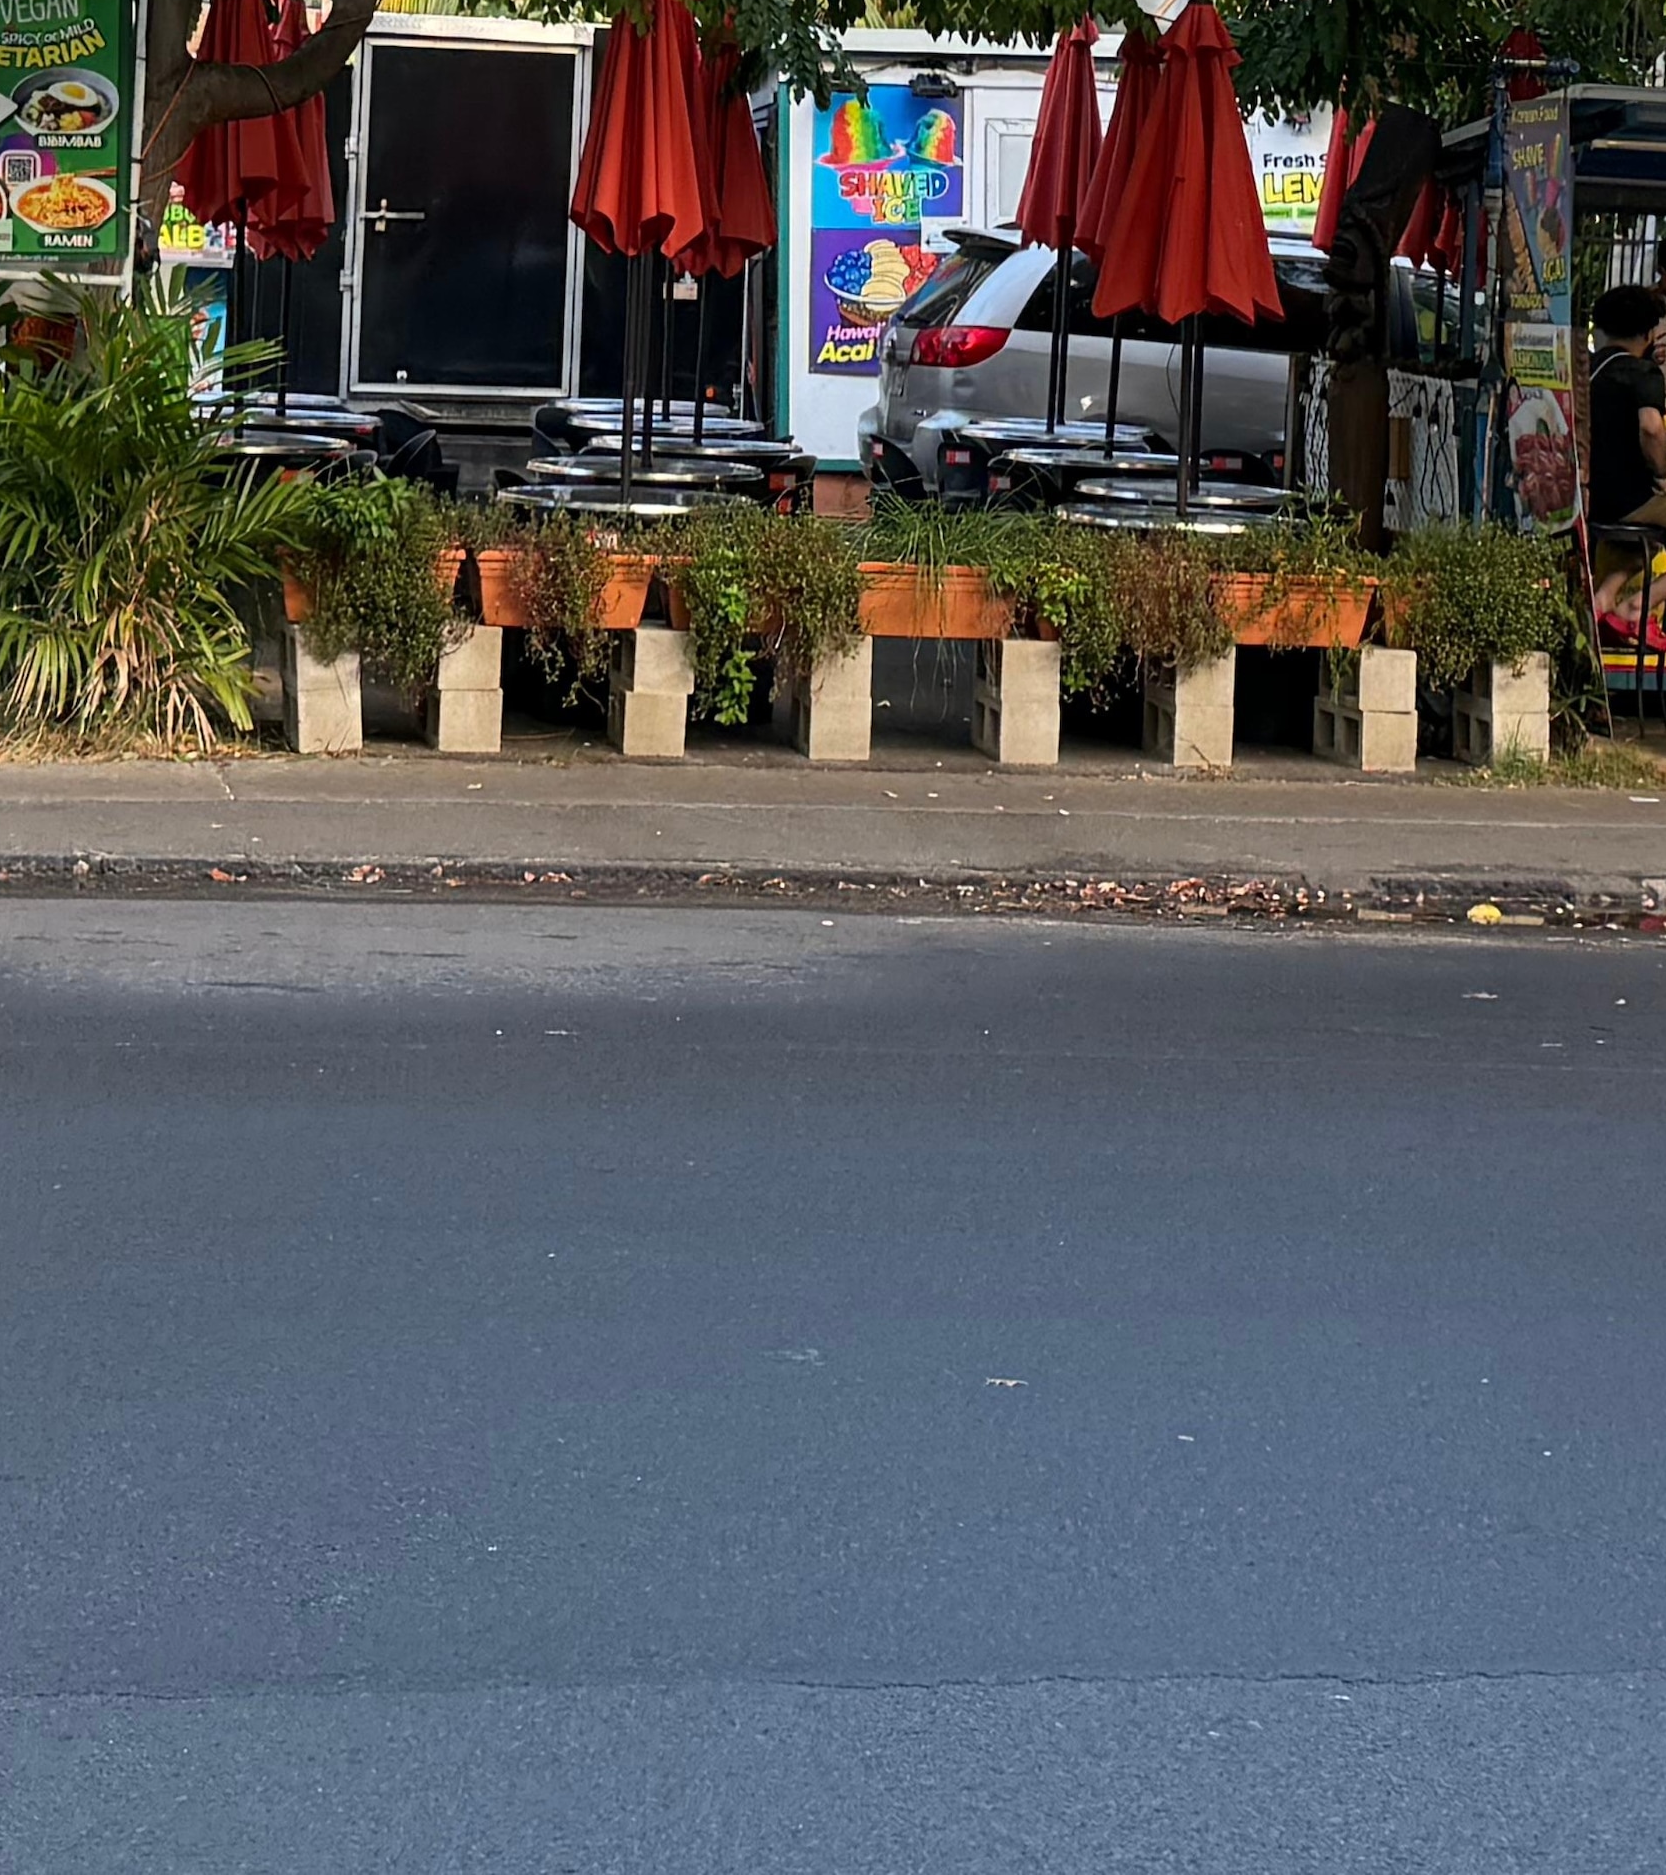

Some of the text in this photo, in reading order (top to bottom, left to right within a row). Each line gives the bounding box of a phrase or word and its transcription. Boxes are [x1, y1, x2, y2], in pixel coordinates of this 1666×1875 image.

[1, 31, 41, 45] SPICY
[59, 18, 95, 41] MILD
[1263, 153, 1315, 168] Fresh
[838, 169, 949, 200] SHAVED
[871, 197, 923, 224] ICE
[44, 234, 94, 247] RAMEN
[158, 225, 206, 248] ALB
[827, 322, 885, 341] Hawai
[817, 339, 874, 365] Acai
